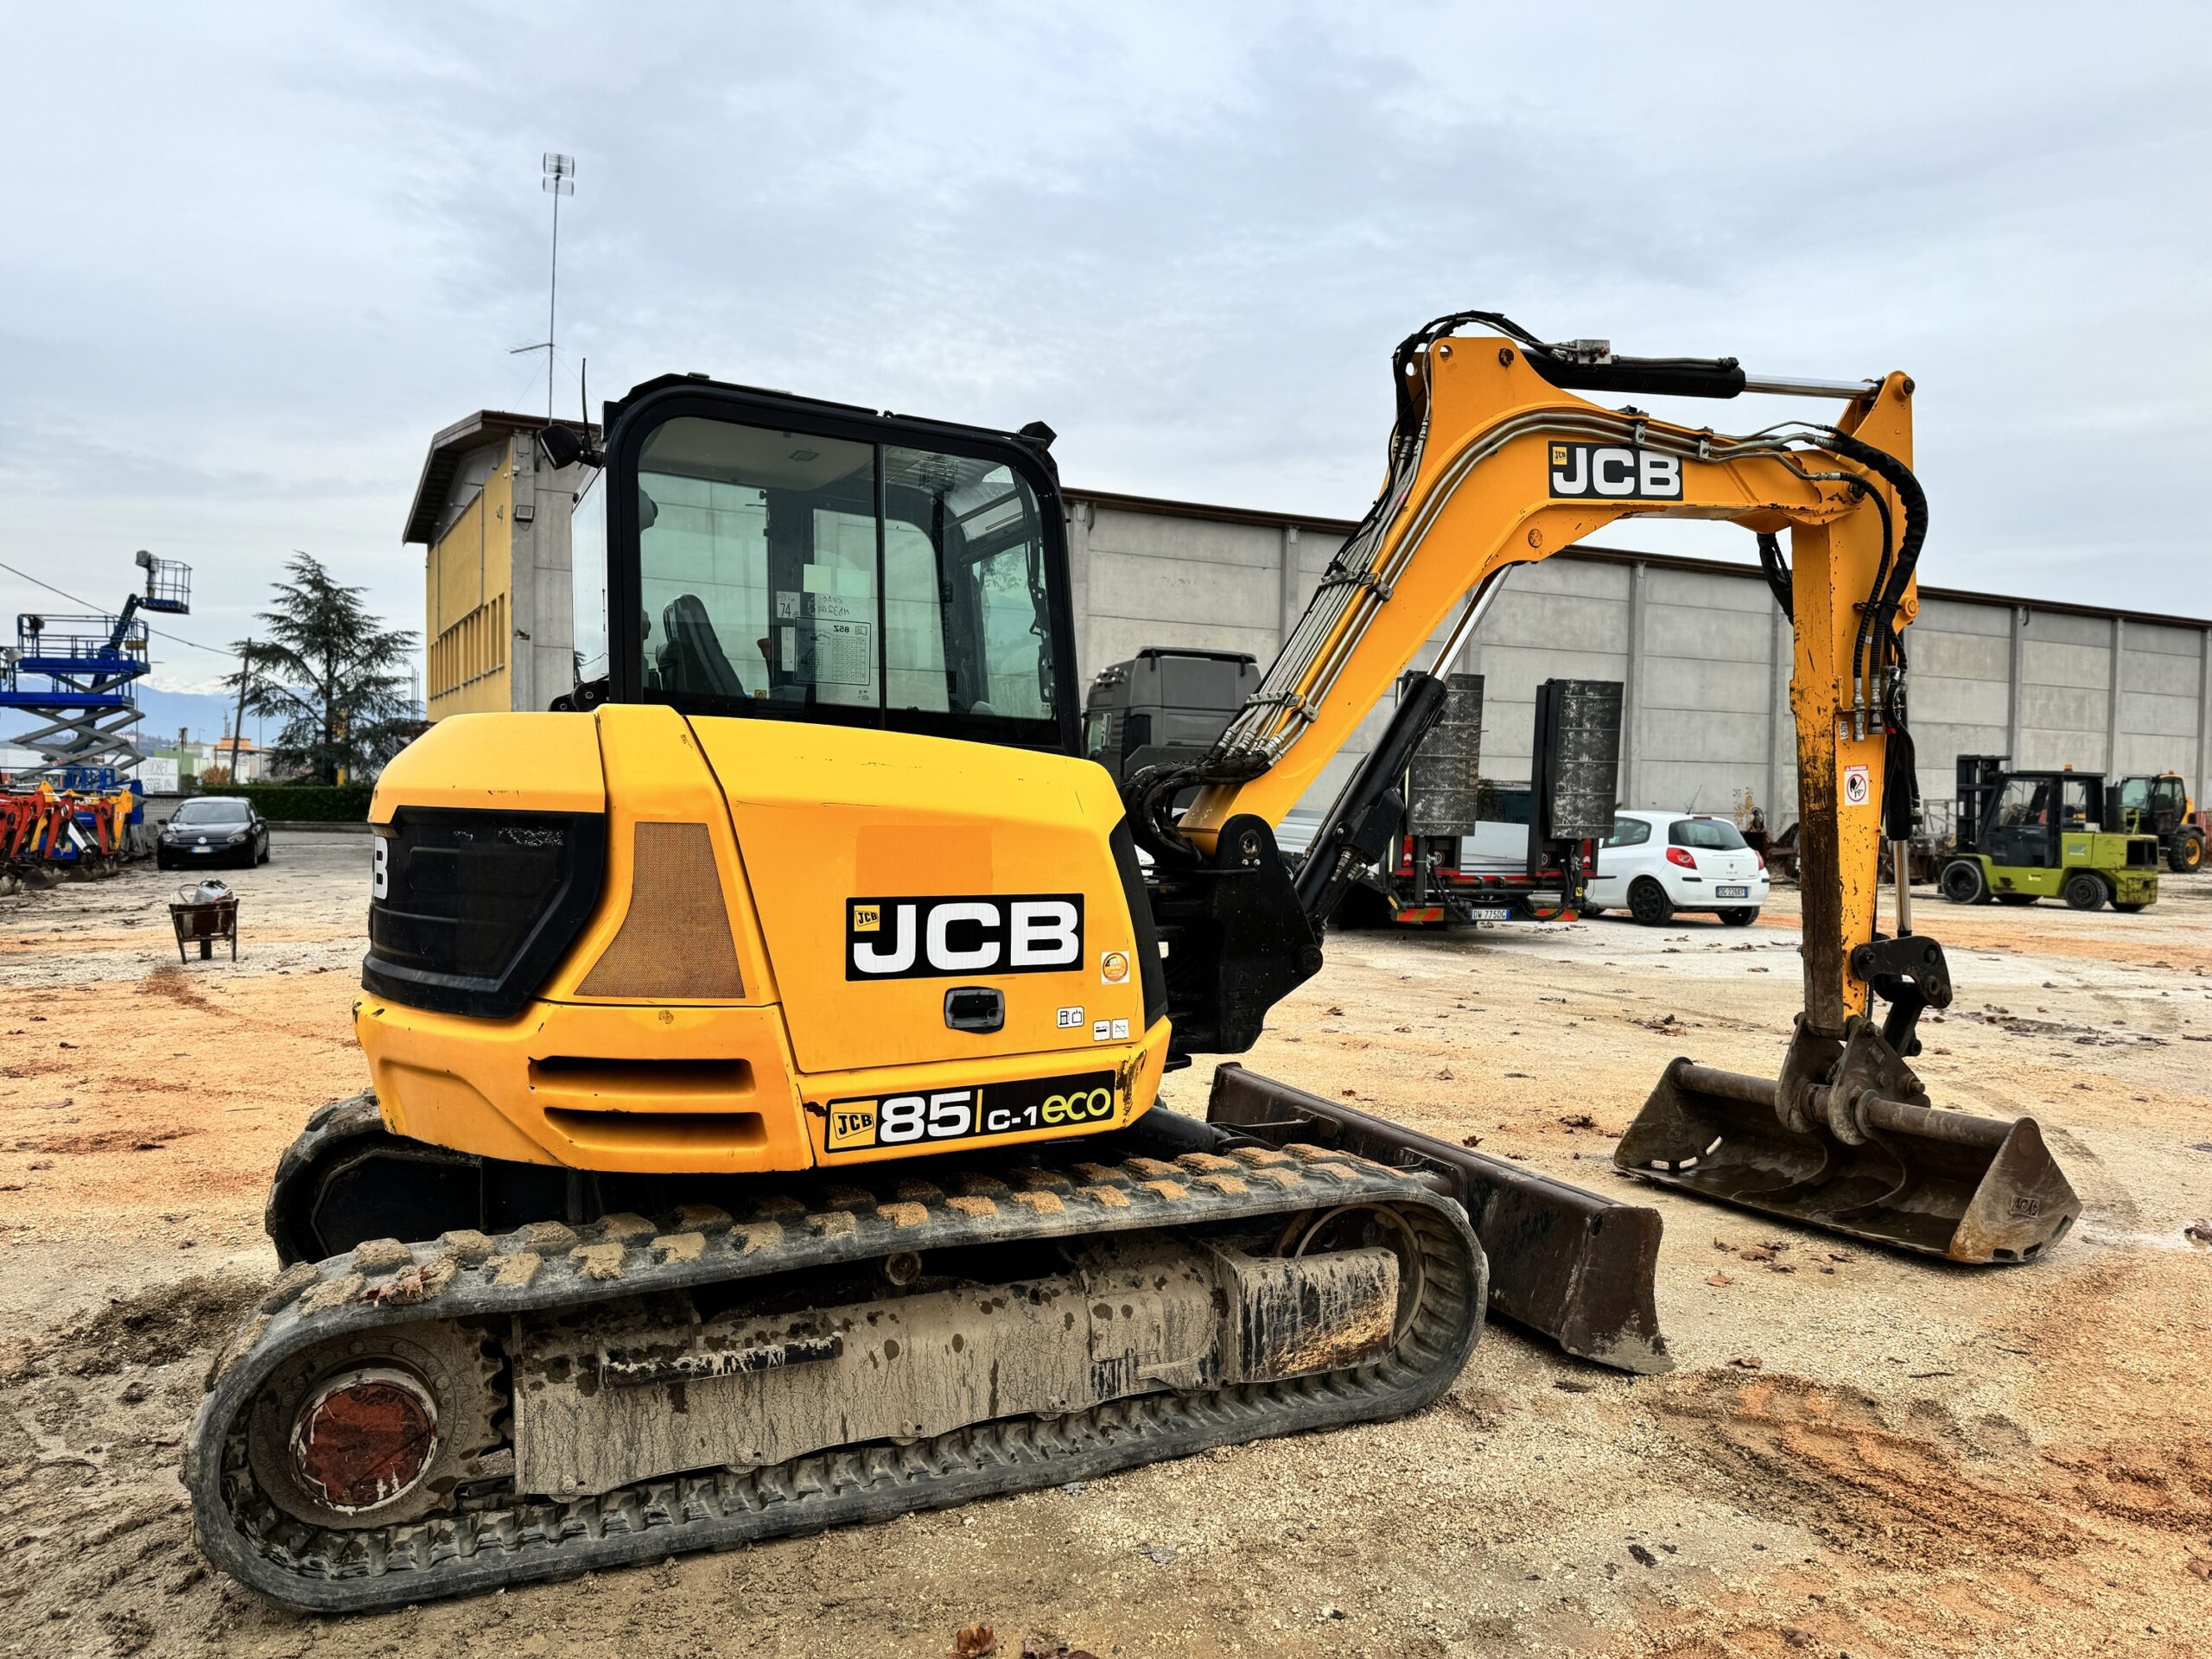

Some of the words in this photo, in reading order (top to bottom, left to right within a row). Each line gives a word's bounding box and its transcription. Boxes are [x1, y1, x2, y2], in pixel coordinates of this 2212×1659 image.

[1554, 451, 1567, 461] JCB
[1553, 448, 1681, 496] JCB
[779, 602, 791, 617] 74
[858, 911, 878, 925] JCB
[853, 901, 1079, 974] JCB
[837, 1113, 873, 1135] JCB
[880, 1090, 971, 1142] 85
[988, 1106, 1037, 1131] C-1
[1042, 1087, 1111, 1123] eco
